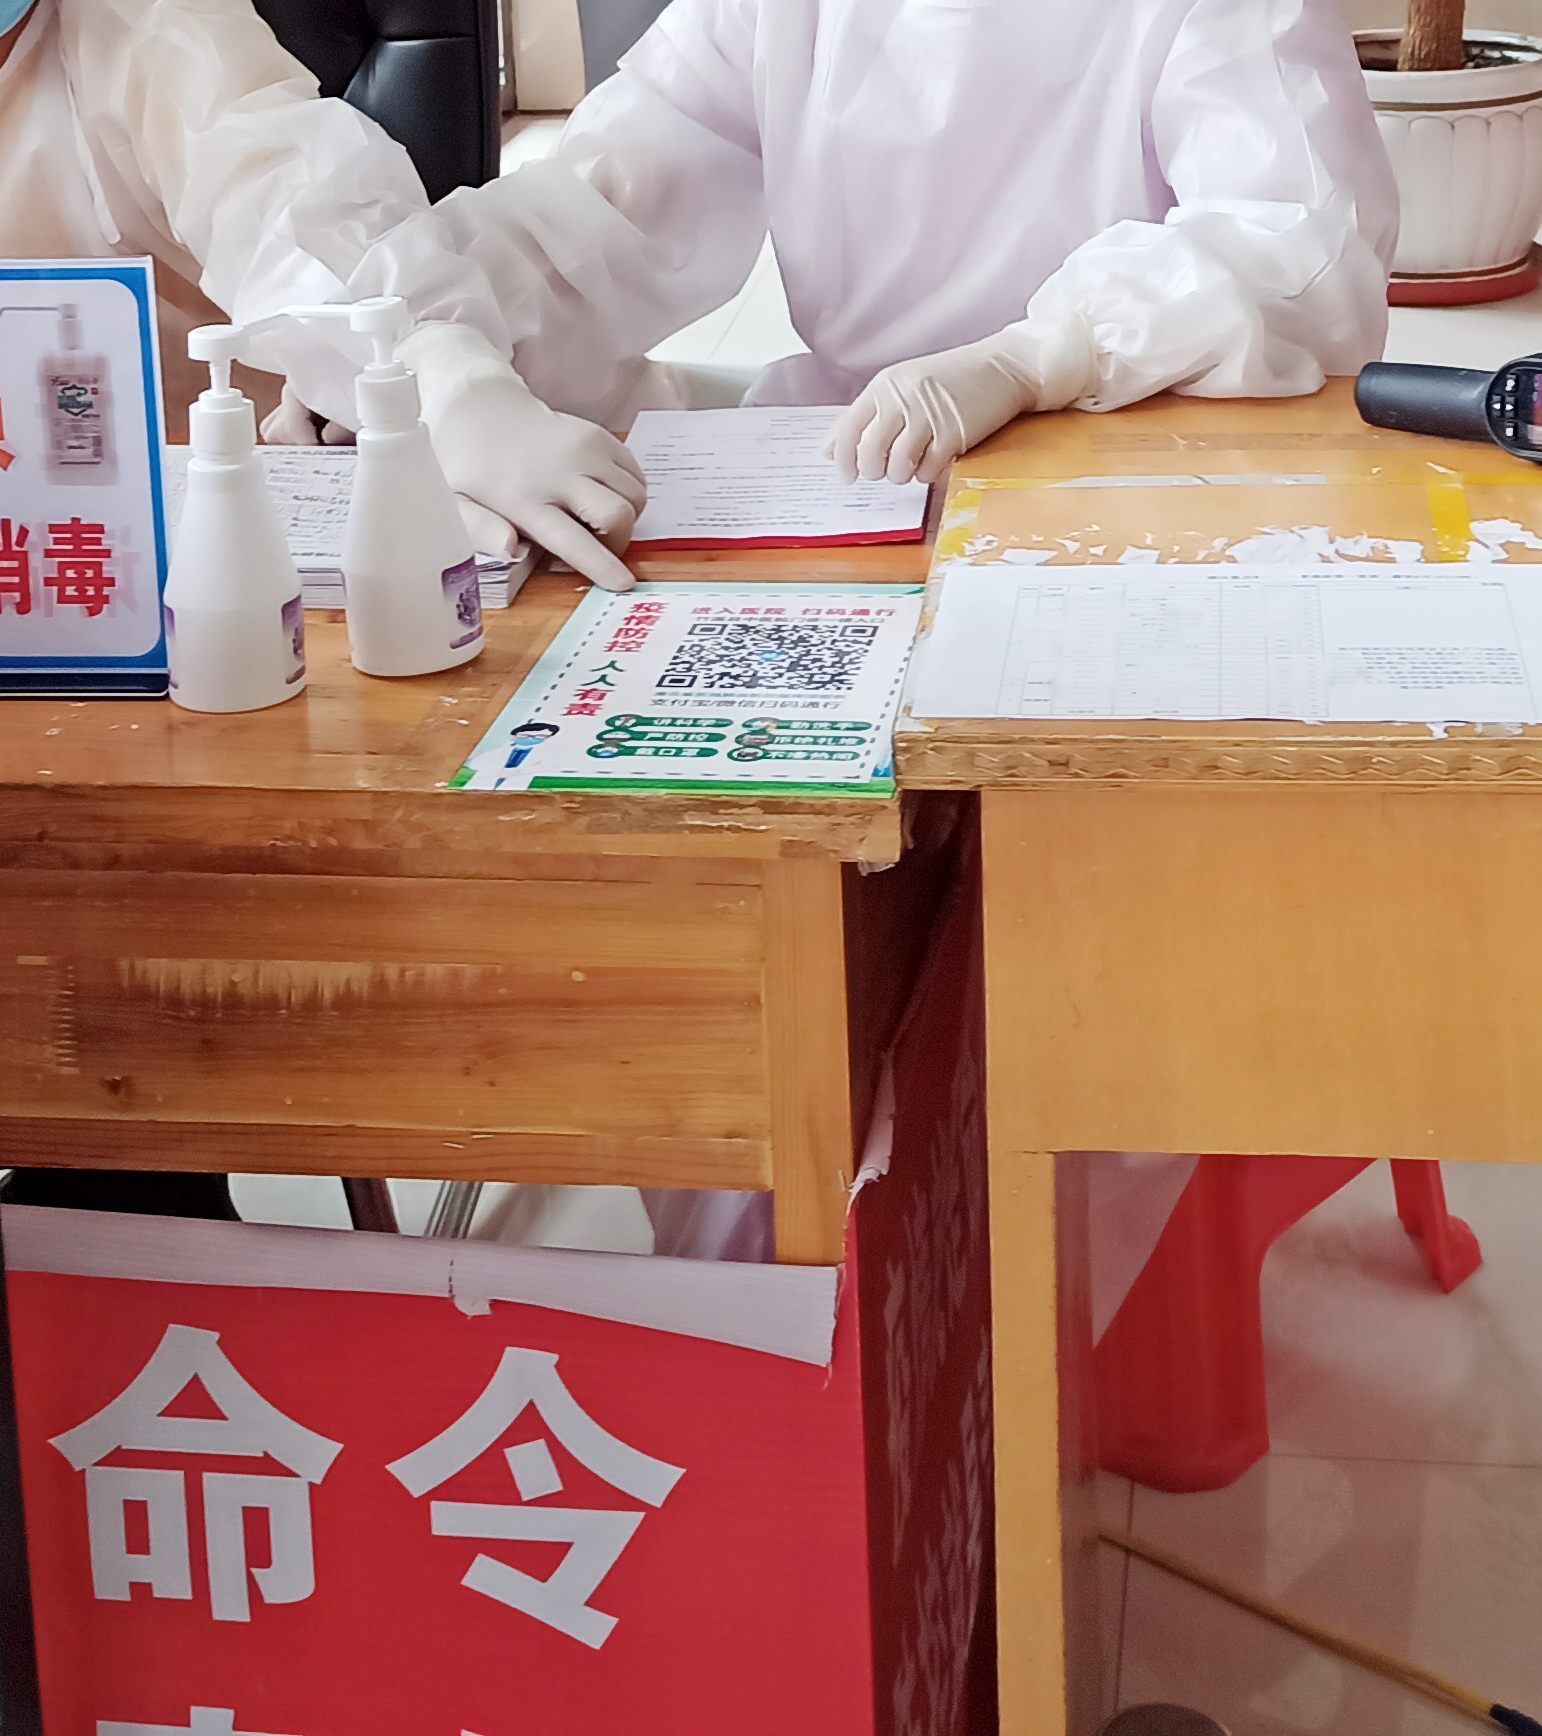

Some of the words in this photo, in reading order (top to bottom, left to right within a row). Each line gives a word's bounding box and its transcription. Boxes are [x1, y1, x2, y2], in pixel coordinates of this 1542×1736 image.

[603, 602, 670, 653] 疫情防控
[560, 660, 627, 717] 人人有责
